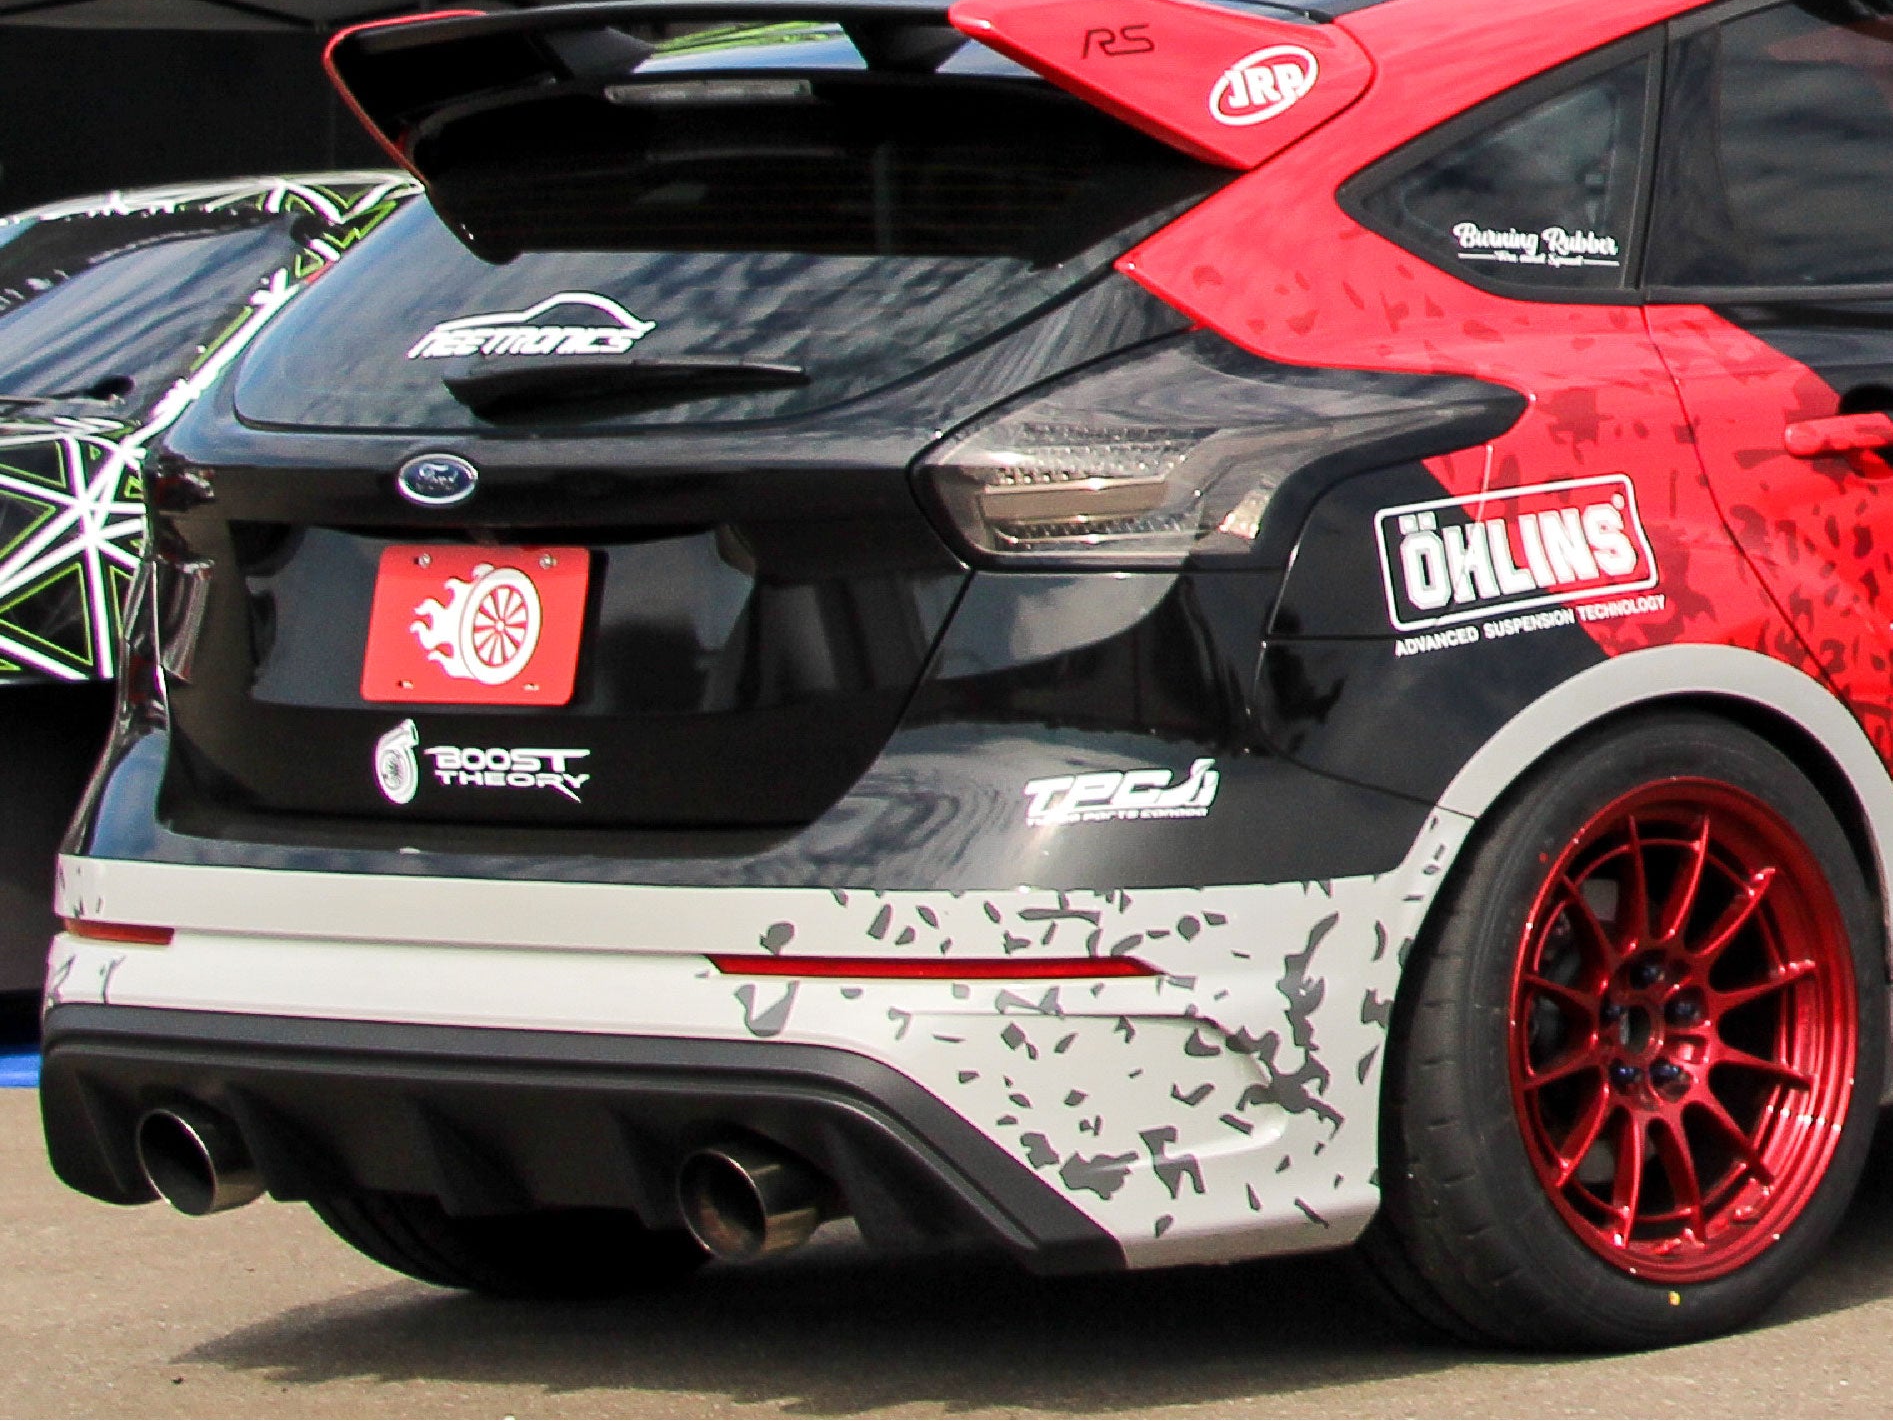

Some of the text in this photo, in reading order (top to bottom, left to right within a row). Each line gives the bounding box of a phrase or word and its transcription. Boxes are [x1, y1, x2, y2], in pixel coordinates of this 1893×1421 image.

[1082, 24, 1154, 60] RS
[1224, 63, 1305, 108] JRP
[1453, 222, 1619, 256] Burning Rubber
[1398, 503, 1638, 610] ÖHLINS
[1395, 594, 1666, 657] ADVANCED SUSPENSION TECHNOLOGY
[423, 746, 591, 772] BOOST
[435, 769, 591, 803] THEORY
